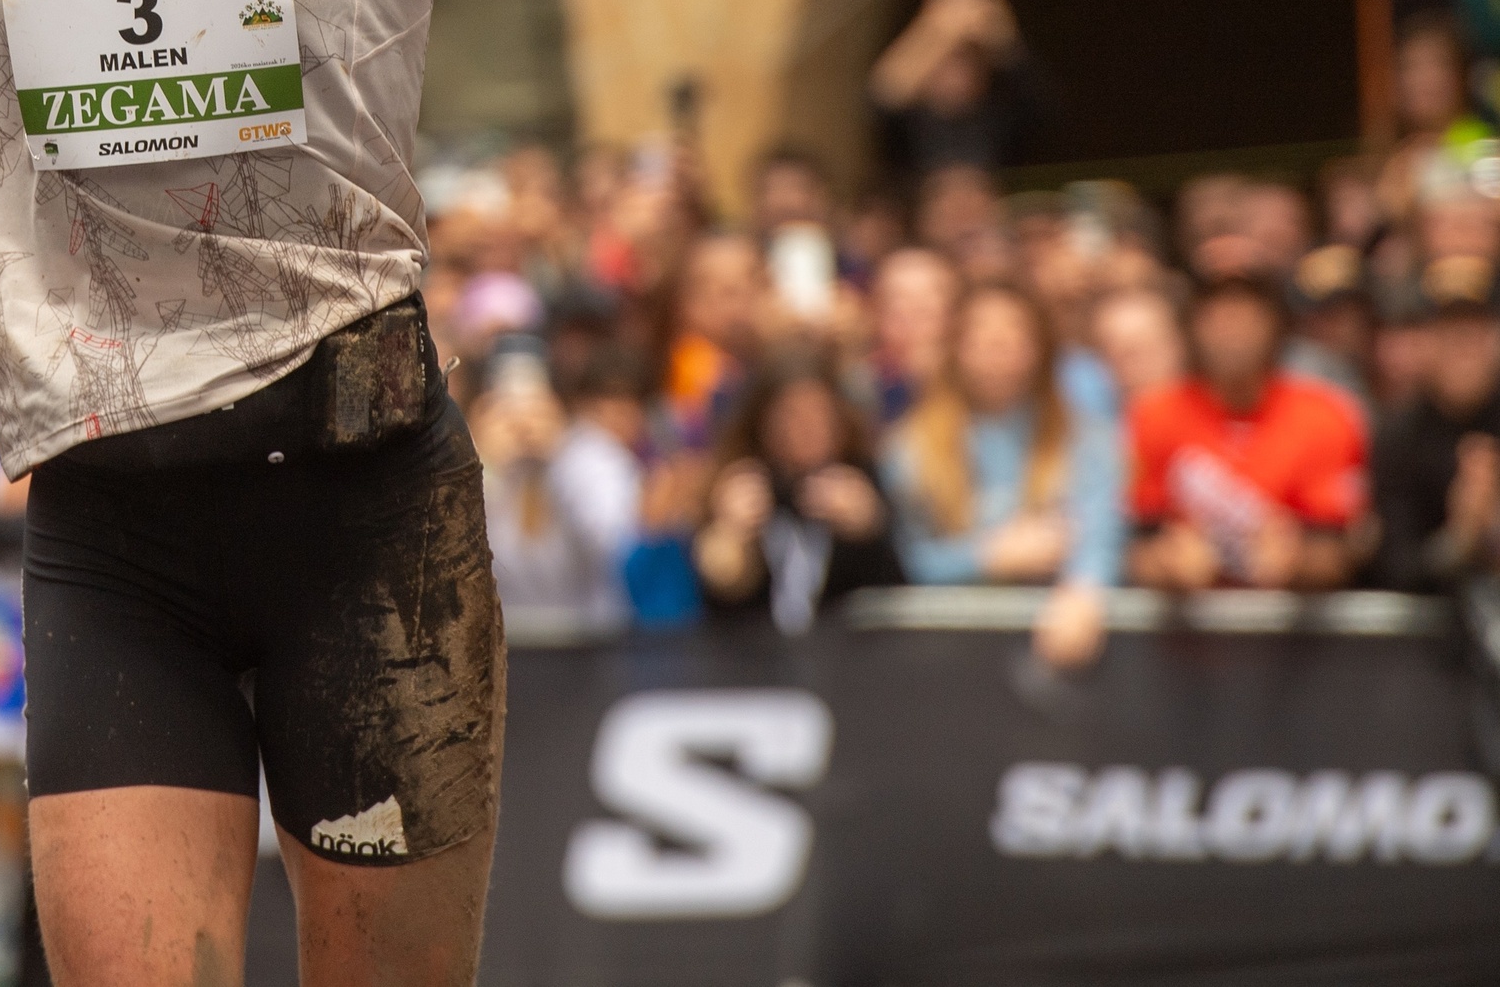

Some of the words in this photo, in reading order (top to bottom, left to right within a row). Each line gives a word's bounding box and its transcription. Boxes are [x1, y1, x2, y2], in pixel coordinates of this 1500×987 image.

[99, 47, 188, 72] MALEN
[42, 73, 271, 130] ZEGAMA
[98, 135, 199, 156] SALOMON
[238, 121, 292, 142] GTWS
[563, 685, 836, 919] S
[990, 760, 1500, 865] SALOMO
